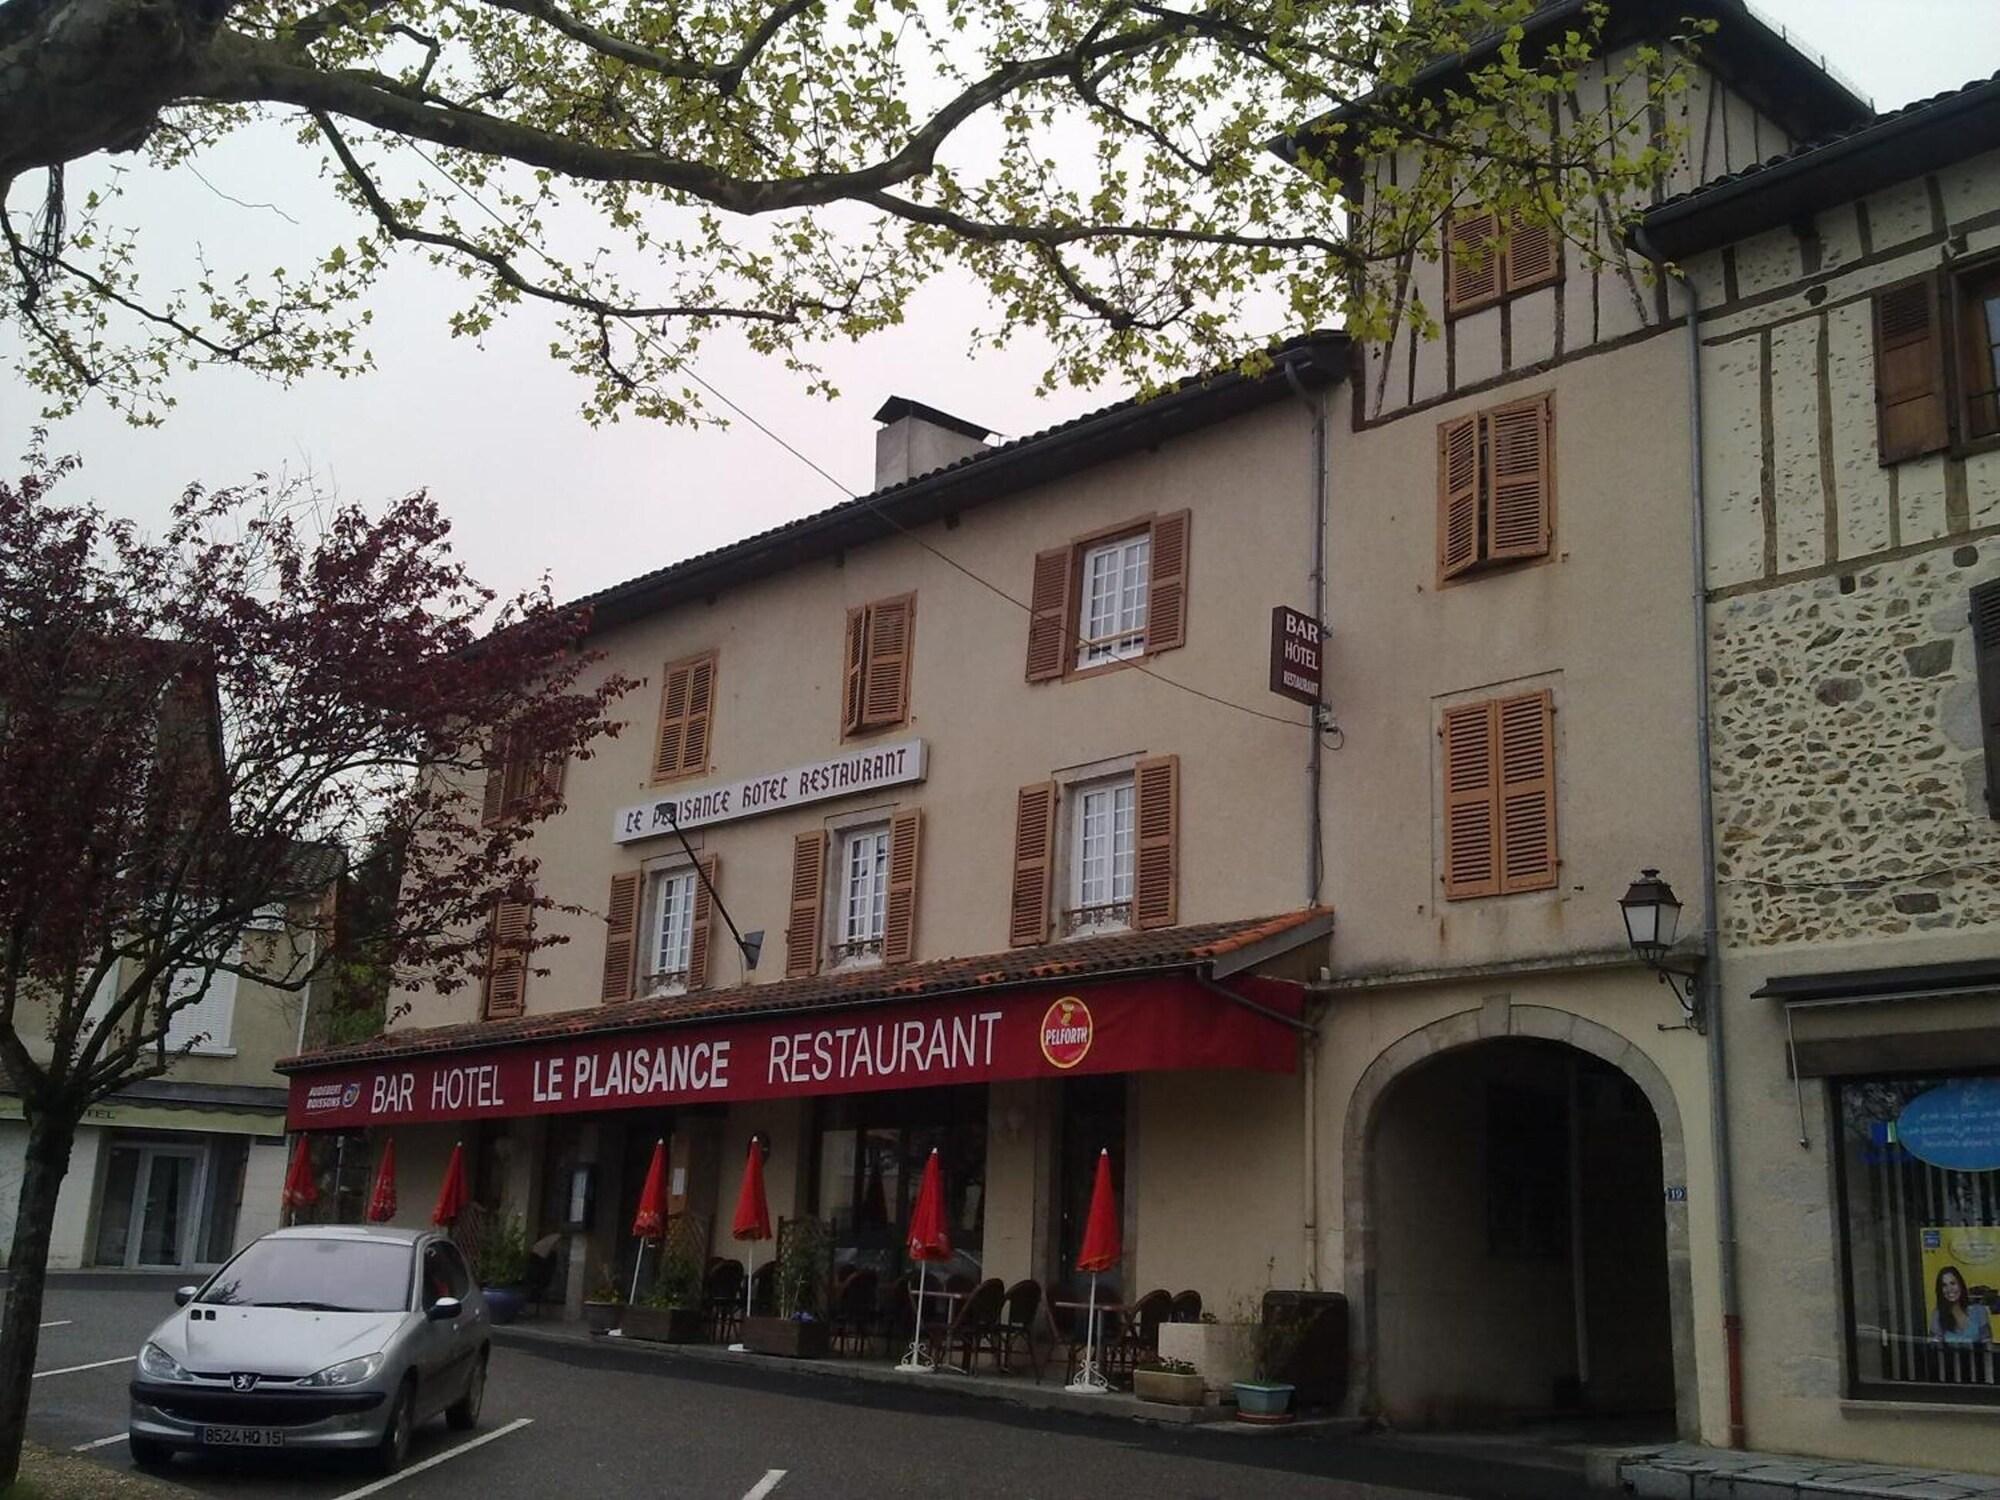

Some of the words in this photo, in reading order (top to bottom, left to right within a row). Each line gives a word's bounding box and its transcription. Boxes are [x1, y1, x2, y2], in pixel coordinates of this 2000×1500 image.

[1285, 613, 1319, 644] BAR
[625, 810, 643, 833] LE
[742, 777, 789, 808] HOTEL
[799, 749, 907, 795] RESTAURANT
[1045, 1026, 1088, 1046] PELFORTH
[371, 1073, 415, 1114] BAR
[431, 1065, 504, 1110] HOTEL
[533, 1058, 564, 1102] LE
[574, 1041, 730, 1099] PLAISANCE
[768, 1012, 1002, 1084] RESTAURANT
[207, 1428, 240, 1443] 8524
[265, 1431, 281, 1445] 15
